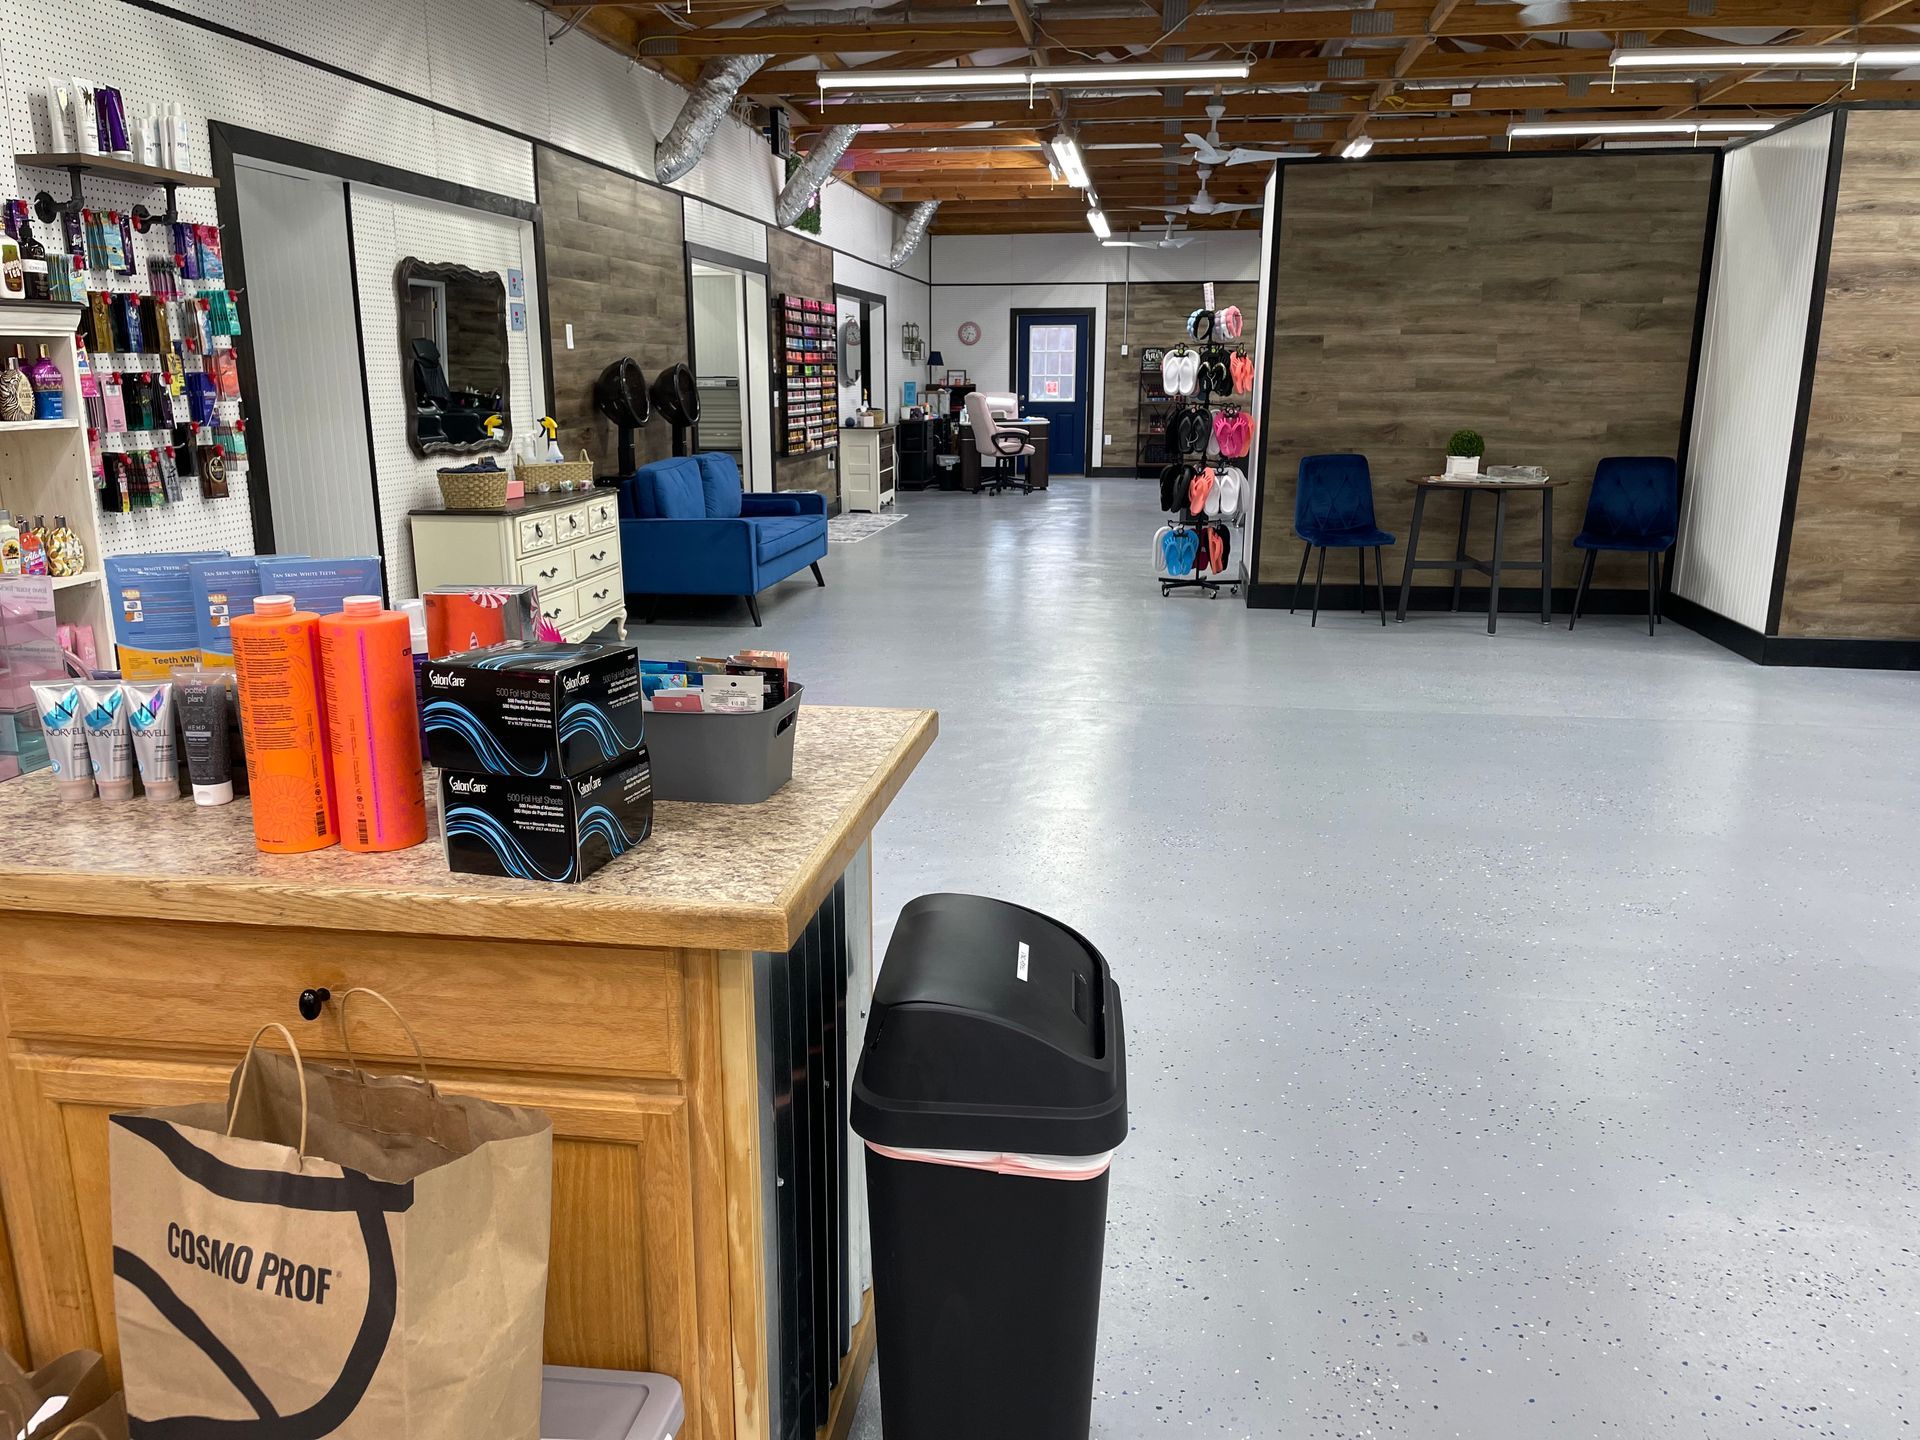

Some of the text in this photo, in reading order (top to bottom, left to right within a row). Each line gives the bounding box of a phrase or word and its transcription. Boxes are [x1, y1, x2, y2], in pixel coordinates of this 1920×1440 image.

[152, 656, 178, 664] Teeth
[184, 687, 206, 695] potted
[496, 688, 550, 700] 500 Foil Half Sheets
[188, 696, 204, 704] plant
[88, 728, 127, 738] NORVELL
[132, 729, 170, 738] NORVELL
[507, 792, 564, 806] 500 Foil Half Sheets
[168, 1222, 332, 1304] COSMO PROF
